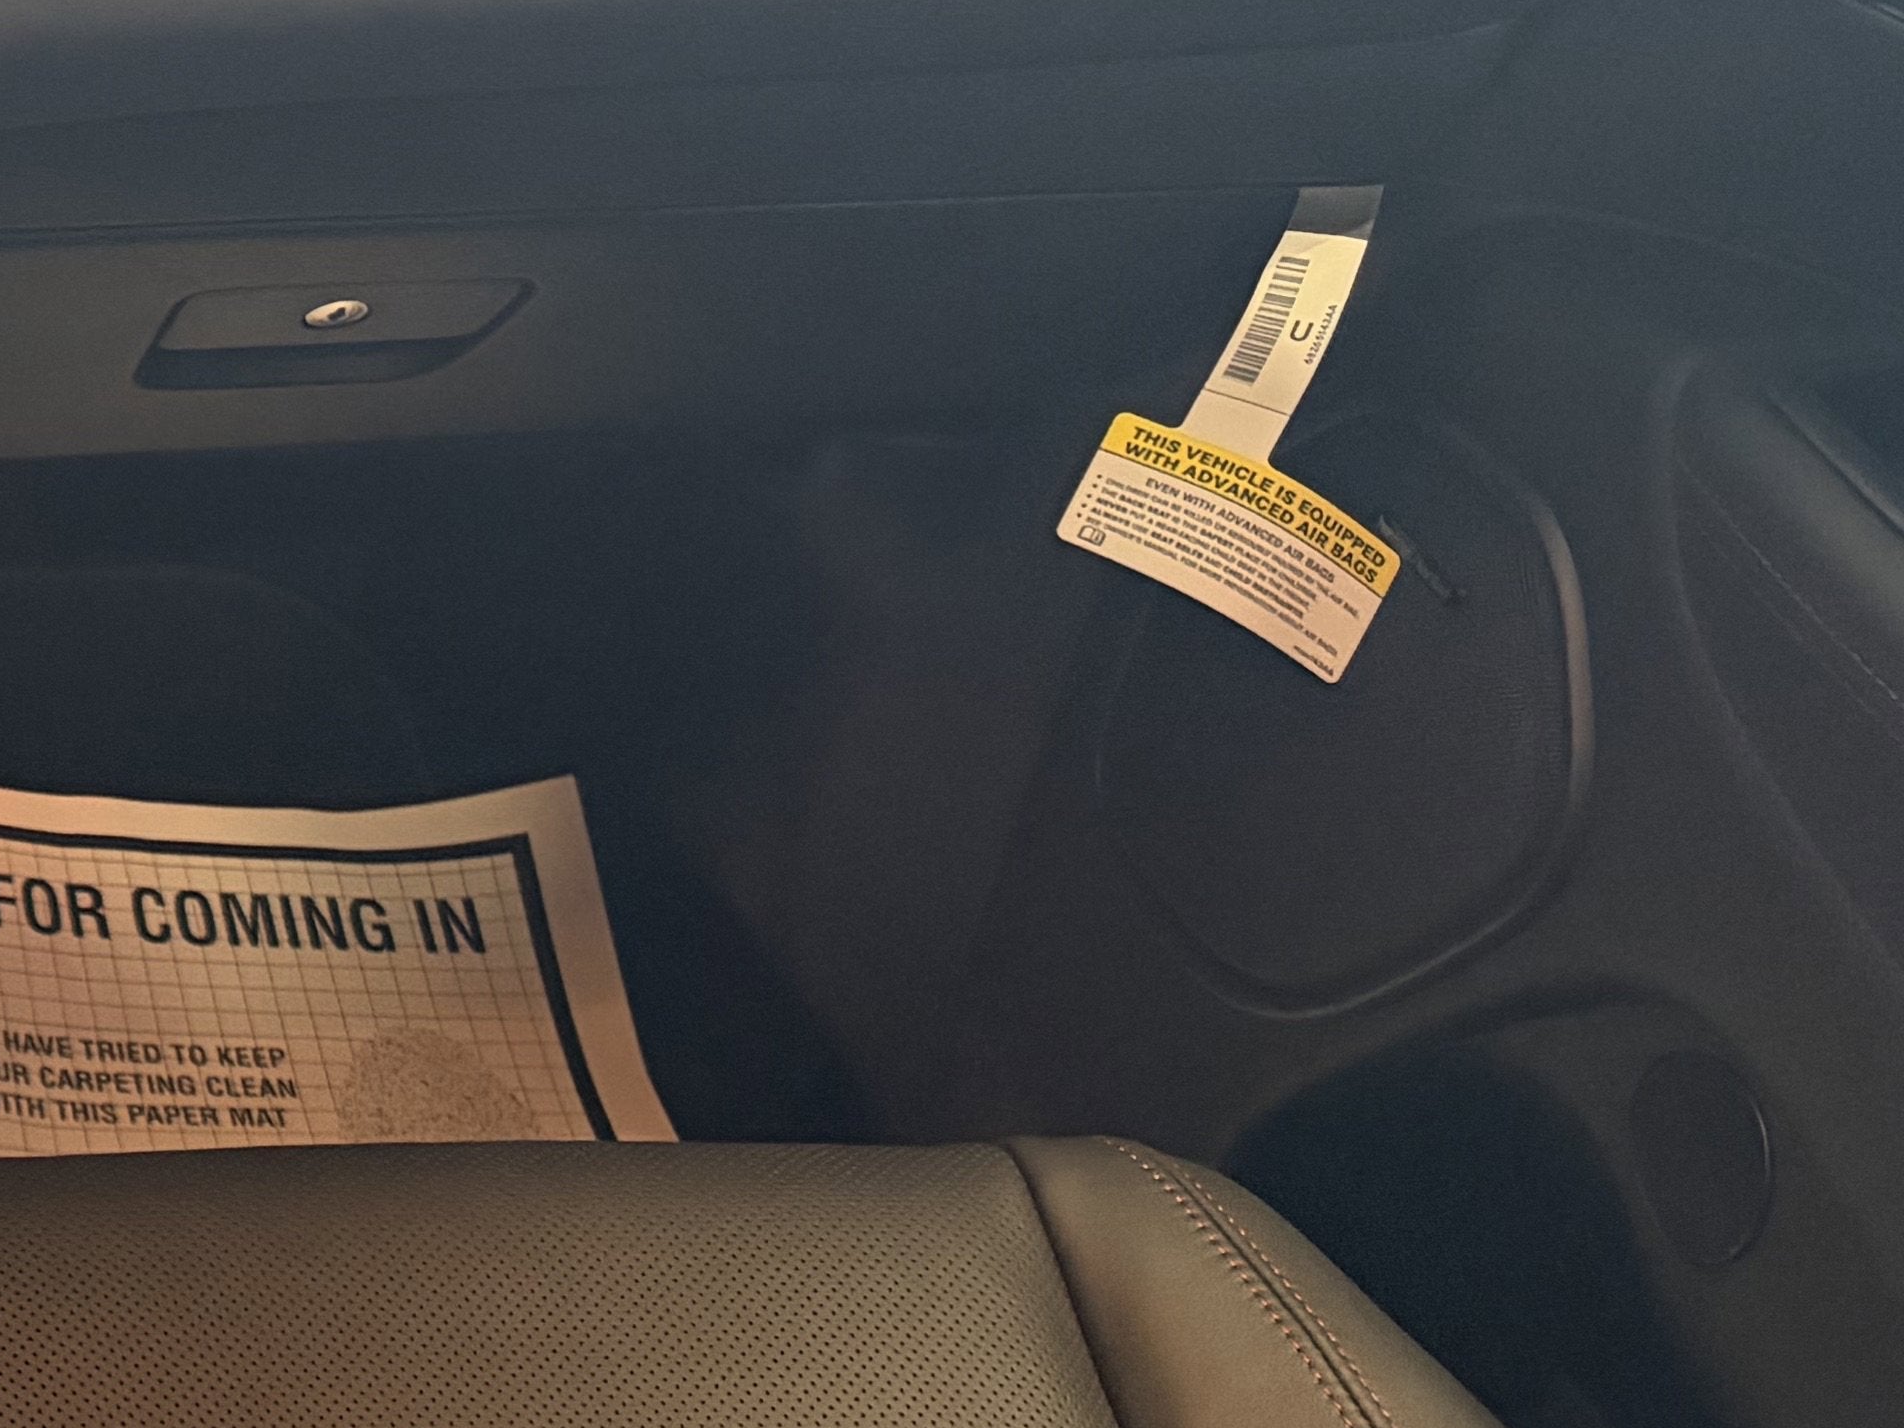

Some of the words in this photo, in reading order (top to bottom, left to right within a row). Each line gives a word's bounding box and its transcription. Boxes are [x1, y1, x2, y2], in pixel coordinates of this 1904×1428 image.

[1290, 320, 1314, 342] U
[1125, 441, 1181, 472] WITH
[1181, 465, 1295, 524] ADVANCED
[1296, 521, 1330, 550] AIR
[1330, 543, 1378, 584] BAGS
[1133, 426, 1182, 453] THIS
[1187, 445, 1275, 493] VEHICLE
[1275, 485, 1297, 506] IS
[1298, 499, 1386, 568] EQUIPPED
[1145, 477, 1181, 498] EVEN
[1183, 492, 1217, 513] WITH
[1217, 507, 1283, 548] ADVANCED
[1284, 545, 1305, 563] AIR
[1305, 556, 1336, 584] BAGS
[131, 887, 396, 957] COMING
[417, 896, 488, 958] IN
[2, 1026, 74, 1061] HAVE
[79, 1037, 163, 1068] TRIED
[169, 1042, 208, 1068] TO
[216, 1044, 287, 1070] KEEP
[39, 1060, 198, 1099] CARPETING
[205, 1074, 298, 1100] CLEAN
[55, 1096, 122, 1124] THIS
[128, 1101, 221, 1128] PAPER
[228, 1105, 289, 1130] MAT
